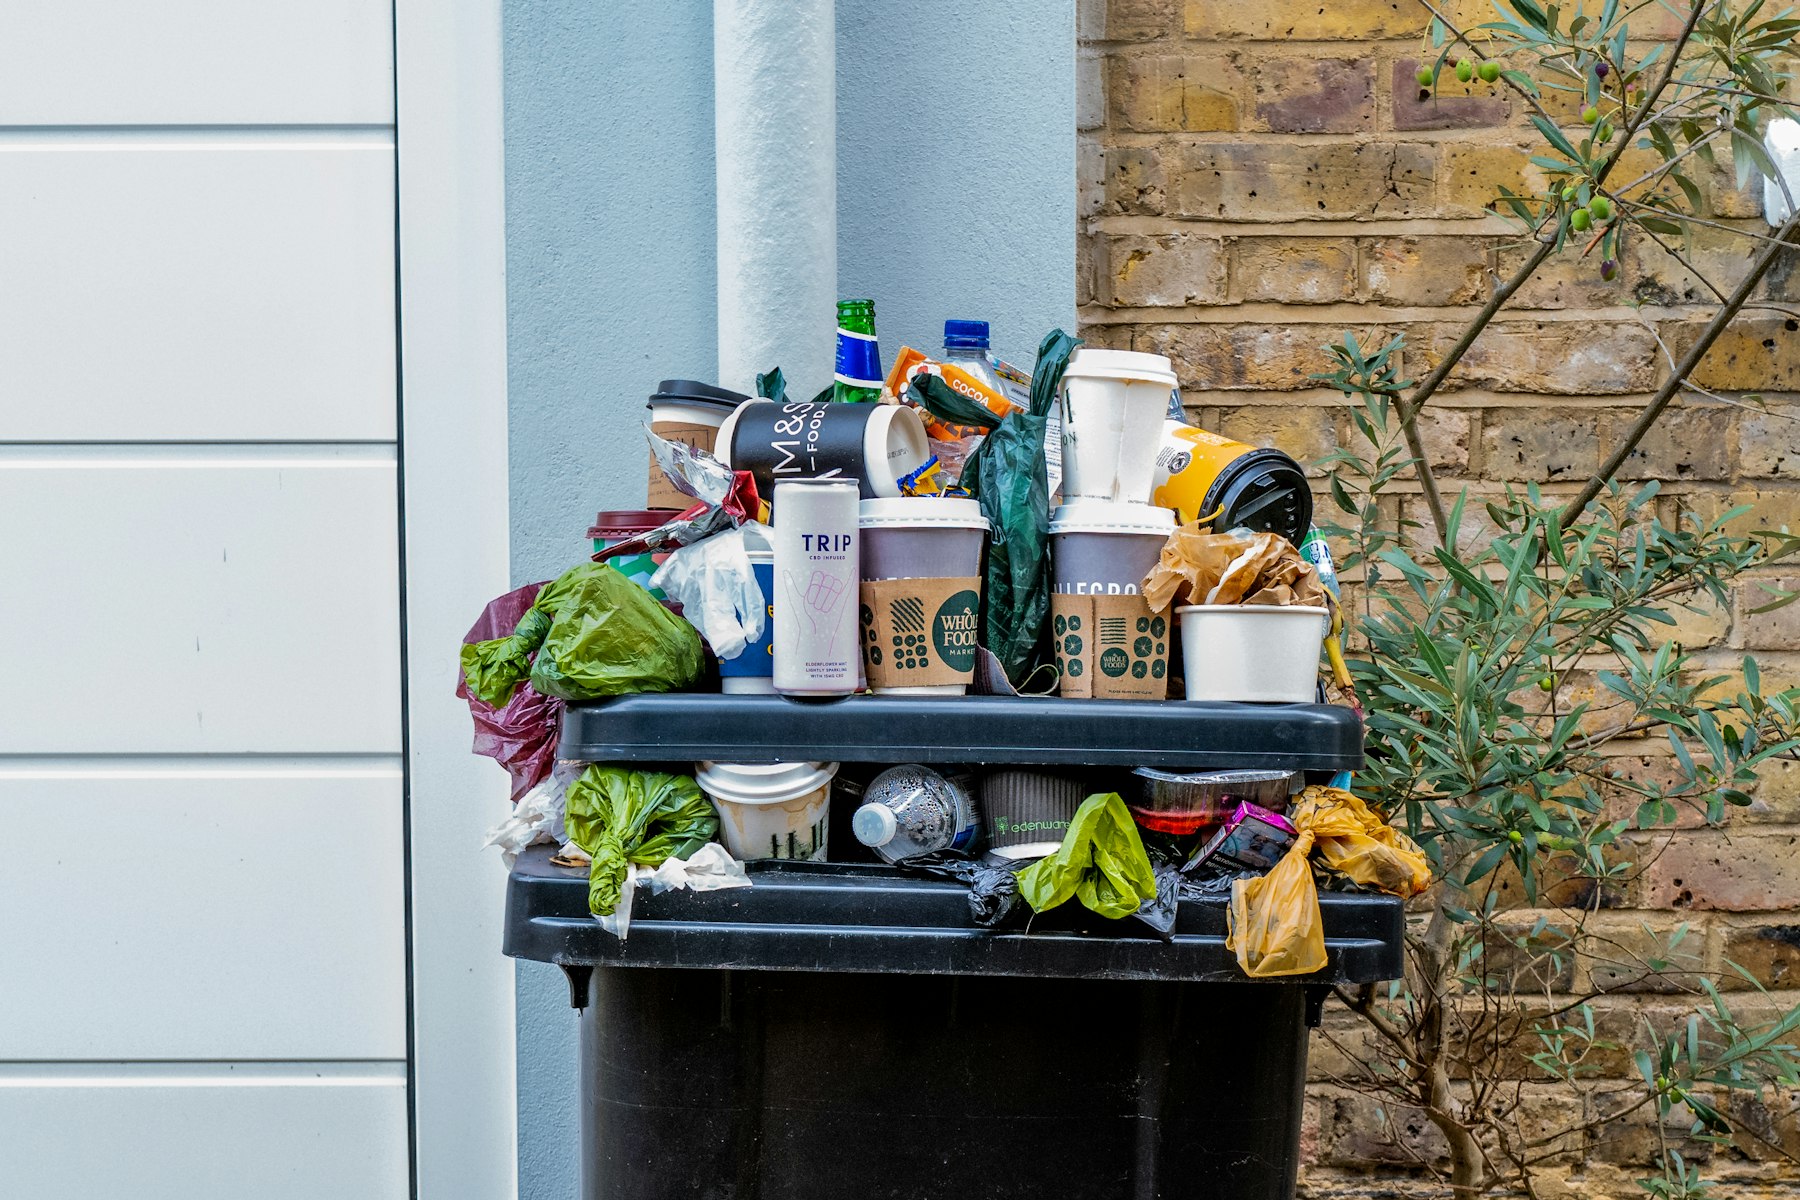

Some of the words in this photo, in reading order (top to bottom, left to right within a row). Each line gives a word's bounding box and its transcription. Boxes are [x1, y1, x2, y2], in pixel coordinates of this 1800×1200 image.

[952, 378, 990, 407] COCOA
[806, 410, 826, 452] FOOD
[801, 534, 852, 552] TRIP
[943, 630, 978, 647] FOOD
[1103, 654, 1126, 663] WHOLE
[1011, 820, 1071, 833] edenware
